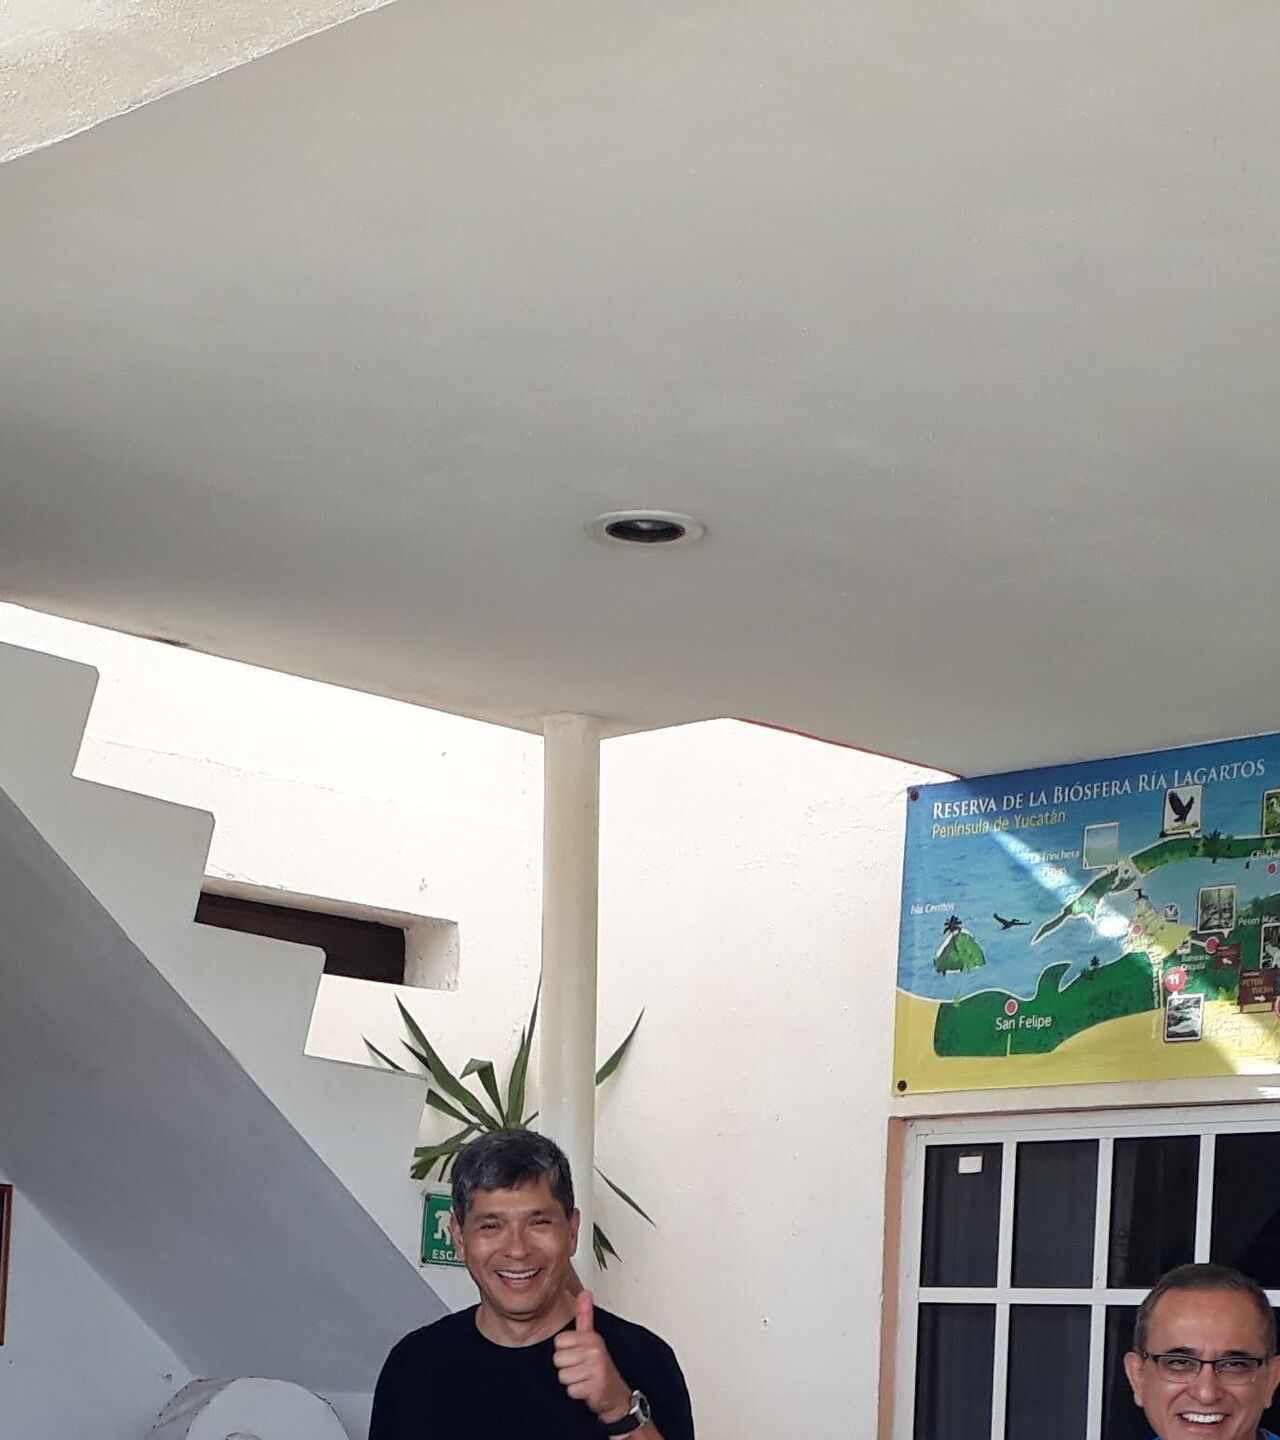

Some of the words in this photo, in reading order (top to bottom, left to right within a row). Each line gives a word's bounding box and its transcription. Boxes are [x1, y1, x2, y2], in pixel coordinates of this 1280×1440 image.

[932, 796, 997, 819] RESERVA
[1002, 794, 1024, 811] DE
[1029, 791, 1048, 808] LA
[1053, 779, 1132, 804] BIÓSFERA
[1138, 772, 1167, 793] RÍA
[1173, 758, 1265, 786] LAGARTOS
[994, 817, 1009, 833] de
[1014, 809, 1066, 829] Yucatán
[995, 1017, 1015, 1031] San
[1018, 1014, 1052, 1031] Felipe
